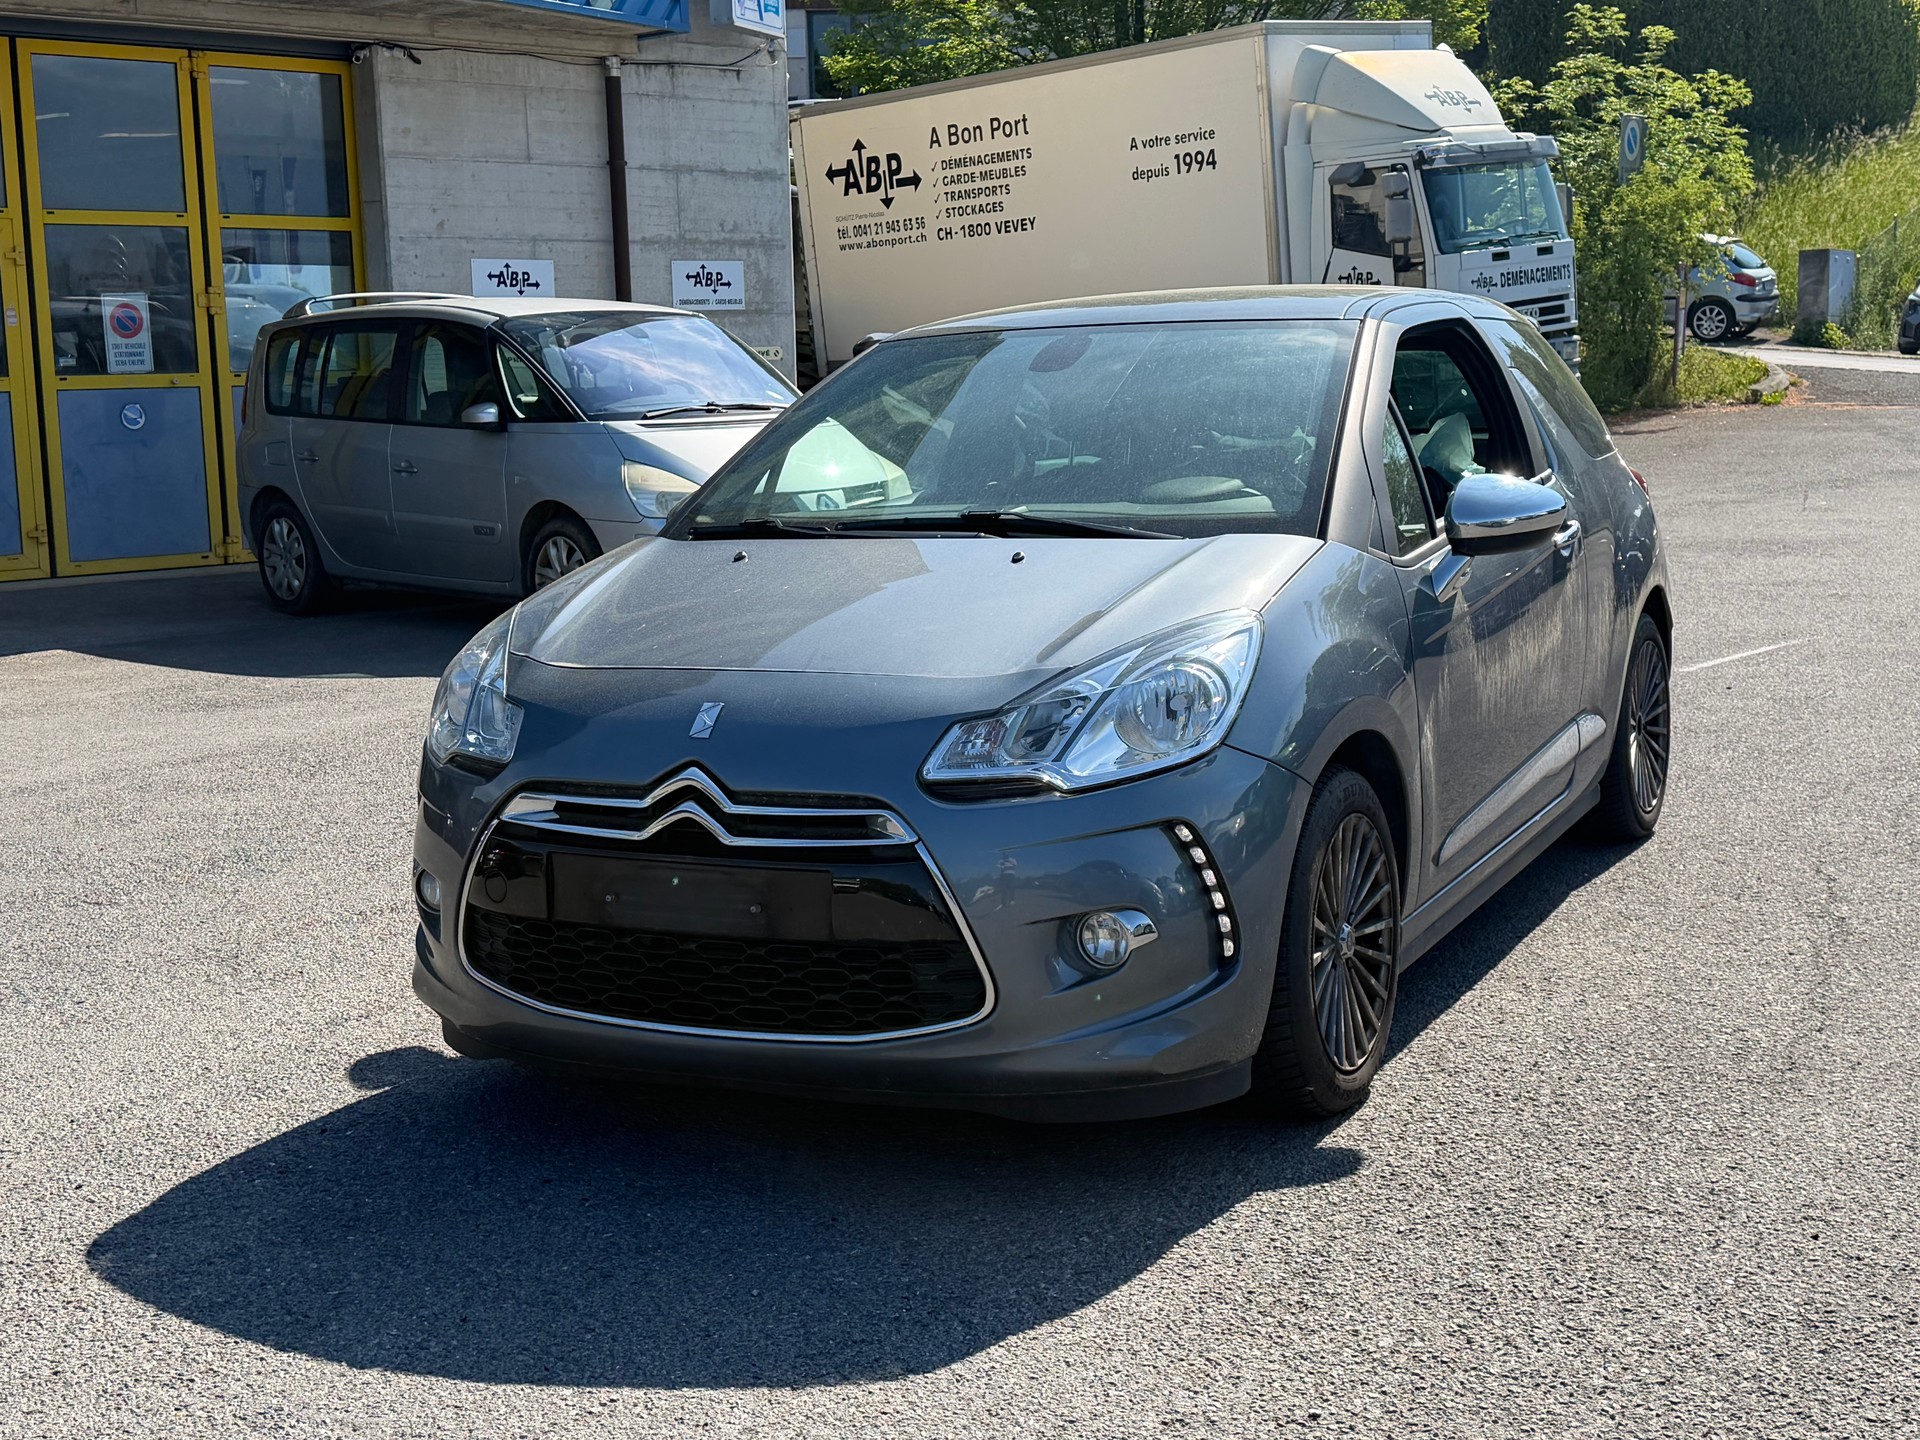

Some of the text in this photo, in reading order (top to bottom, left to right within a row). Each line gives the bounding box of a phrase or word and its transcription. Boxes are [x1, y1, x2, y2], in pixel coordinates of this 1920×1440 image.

[929, 114, 1029, 149] A Bon Port
[1129, 127, 1215, 151] A votre service
[941, 147, 1033, 171] DÉMÉNAGEMENTS
[1131, 148, 1217, 183] depuis 1994
[942, 165, 1027, 187] GARDE-MEUBLES
[943, 183, 1011, 203] TRANSPORTS
[945, 201, 1004, 219] STOCKAGES
[837, 216, 926, 240] tél. 0041 21 943 63 56
[995, 216, 1037, 235] VEVEY
[839, 232, 927, 252] www.abonport.ch
[1500, 264, 1571, 288] DÉMÉNAGEMENTS
